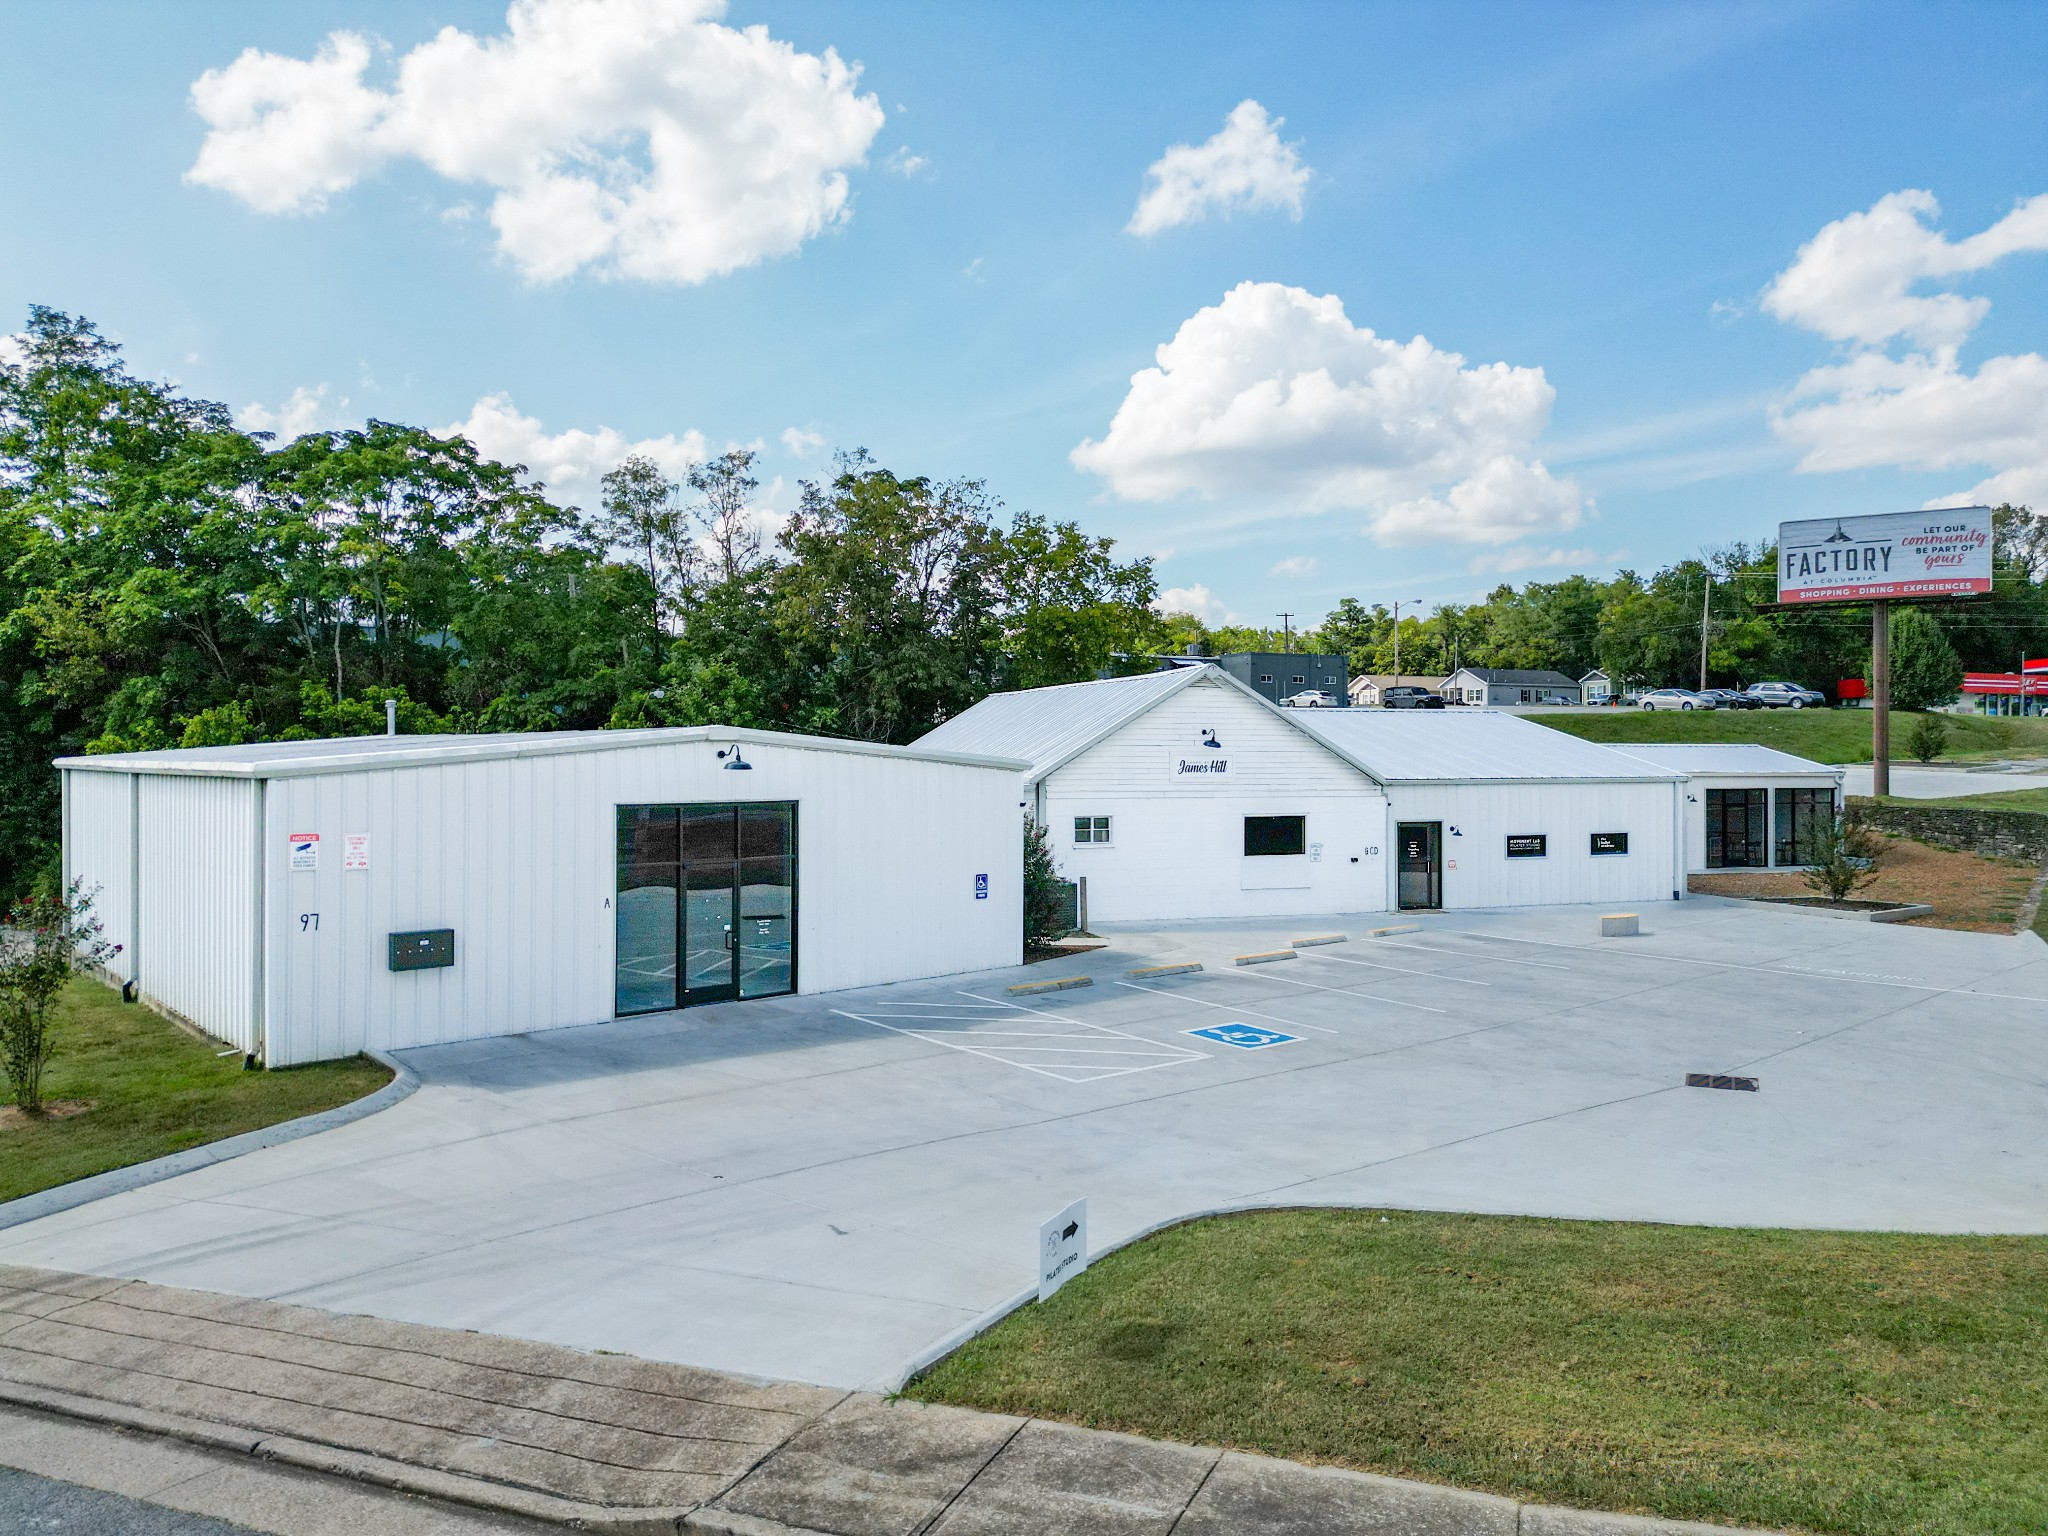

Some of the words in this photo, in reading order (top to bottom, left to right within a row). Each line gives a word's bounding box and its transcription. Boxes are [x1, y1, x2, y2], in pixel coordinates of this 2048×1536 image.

[1901, 528, 1988, 547] community
[1923, 526, 1941, 534] LET
[1944, 524, 1966, 532] OUR
[1931, 545, 1957, 553] PART
[1960, 544, 1975, 552] OF
[1786, 546, 1893, 579] FACTORY
[1924, 553, 1965, 570] yours
[1800, 588, 1850, 599] SHOPPING
[1858, 585, 1894, 595] DINING
[1903, 582, 1972, 592] EXPERIENCES
[1178, 760, 1208, 774] James
[1209, 760, 1228, 773] Hill
[604, 898, 611, 908] A
[300, 913, 319, 931] 97
[1061, 1252, 1078, 1270] STUDIO
